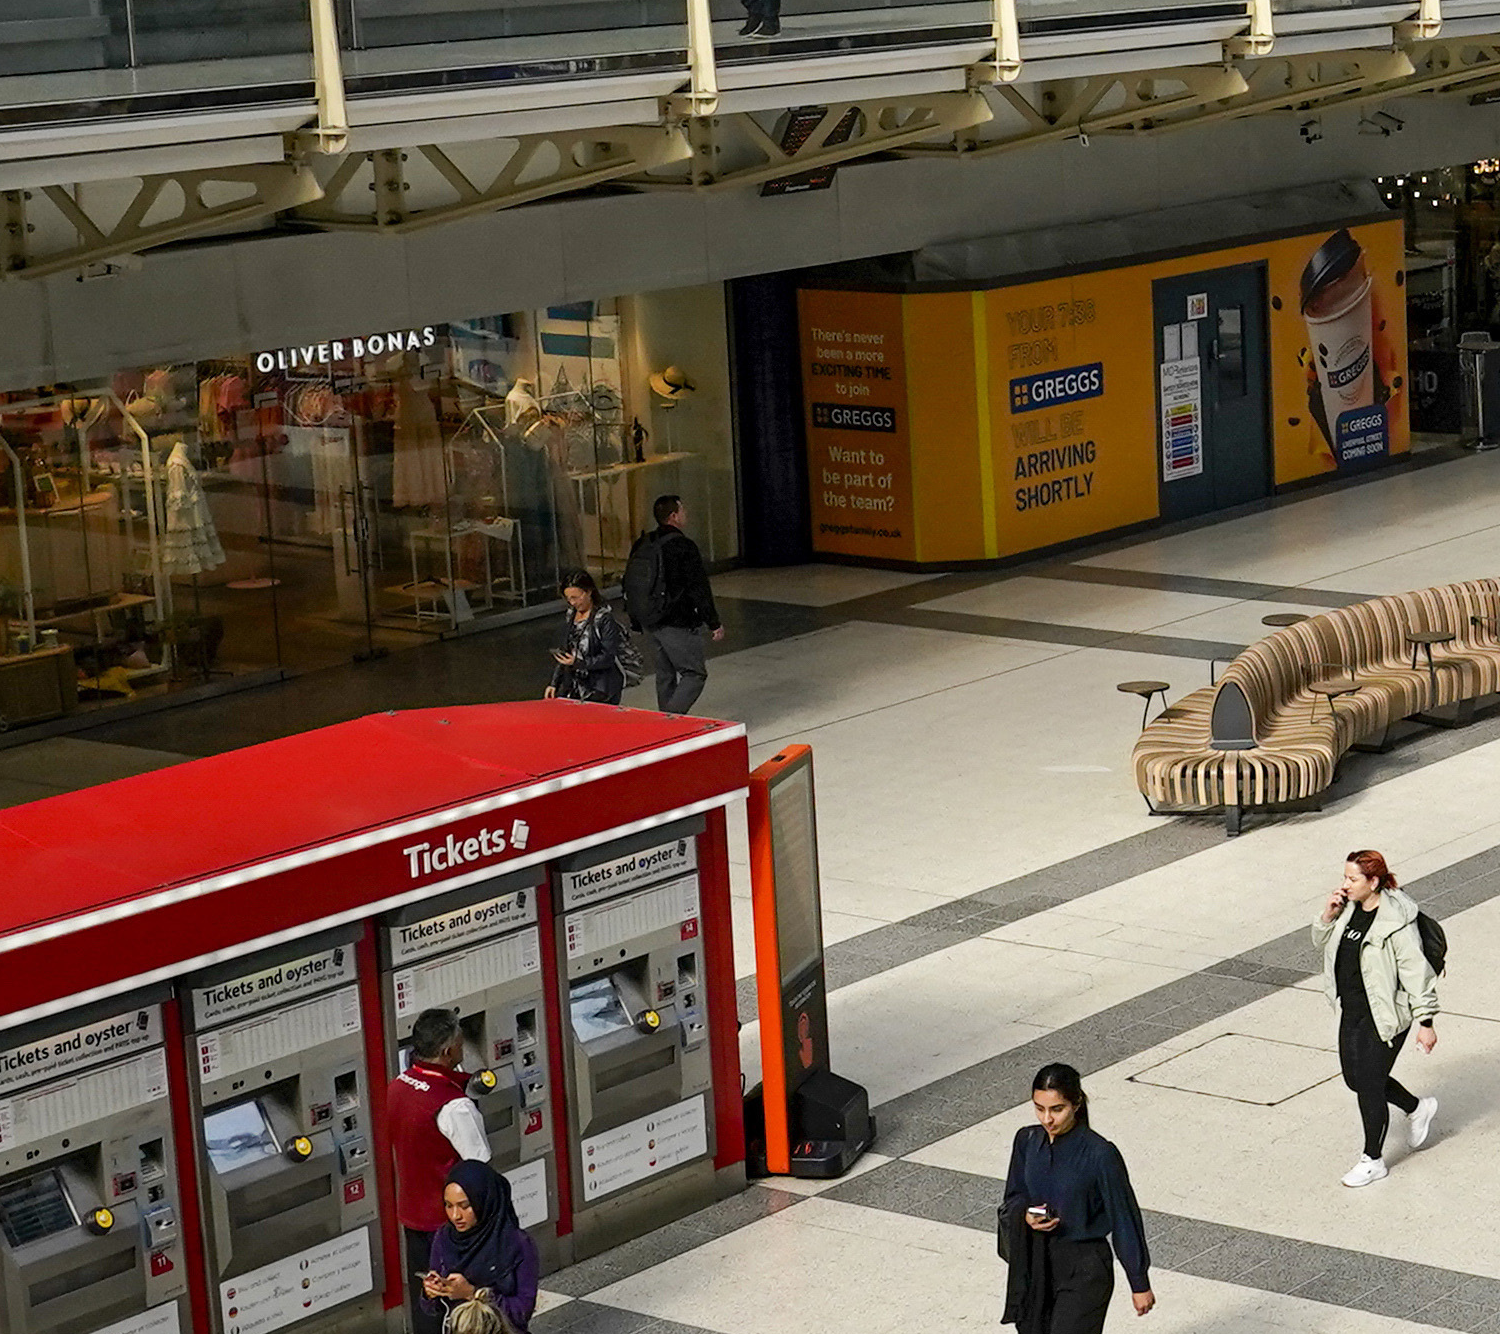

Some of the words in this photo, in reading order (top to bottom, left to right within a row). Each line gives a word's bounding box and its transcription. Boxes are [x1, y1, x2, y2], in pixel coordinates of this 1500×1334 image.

[811, 328, 851, 344] There's
[853, 332, 884, 344] never
[1005, 306, 1053, 336] YOUR
[256, 340, 344, 373] OLIVER
[352, 326, 436, 358] BONAS
[816, 347, 844, 359] been
[855, 351, 884, 362] more
[1008, 339, 1058, 368] FROM
[811, 362, 863, 378] EXCITING
[865, 367, 892, 380] TIME
[1031, 369, 1100, 402] GREGGS
[835, 383, 847, 395] to
[849, 384, 870, 397] join
[831, 408, 892, 428] GREGGS
[1011, 419, 1057, 449] WILL
[1060, 410, 1085, 439] BE
[1349, 414, 1383, 433] GREGGS
[828, 446, 866, 464] Want
[870, 450, 884, 465] to
[1014, 440, 1096, 480] ARRIVING
[822, 468, 840, 484] be
[844, 470, 874, 489] part
[878, 473, 892, 489] of
[1015, 472, 1094, 512] SHORTLY
[823, 490, 846, 507] the
[850, 493, 895, 512] team?
[403, 828, 507, 878] Tickets
[570, 868, 613, 889] Tickets
[615, 857, 636, 876] and
[638, 848, 674, 870] oyster
[400, 919, 445, 944] Tickets
[449, 909, 471, 930] and
[474, 900, 513, 923] oyster
[202, 980, 254, 1006] Tickets
[258, 968, 283, 990] and
[286, 957, 329, 983] oyster
[54, 1033, 81, 1056] and
[85, 1021, 132, 1048] oyster
